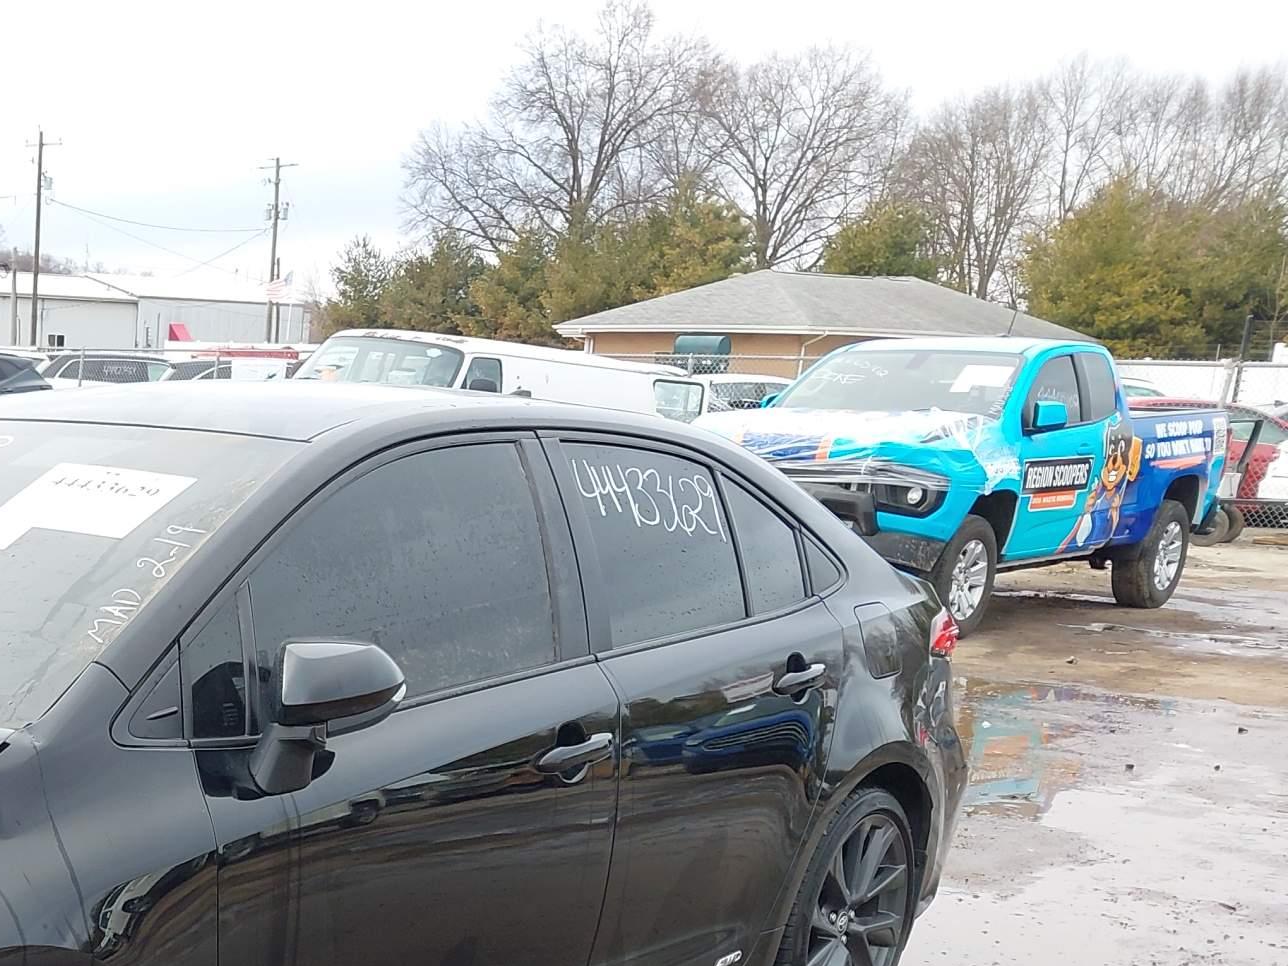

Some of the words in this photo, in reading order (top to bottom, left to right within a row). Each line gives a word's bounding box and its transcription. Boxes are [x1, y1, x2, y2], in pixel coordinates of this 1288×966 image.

[1157, 440, 1171, 458] YOU
[1025, 465, 1054, 489] REGION
[1053, 463, 1090, 487] SCOOPERS
[572, 459, 727, 543] 44433629
[87, 588, 142, 643] MAD
